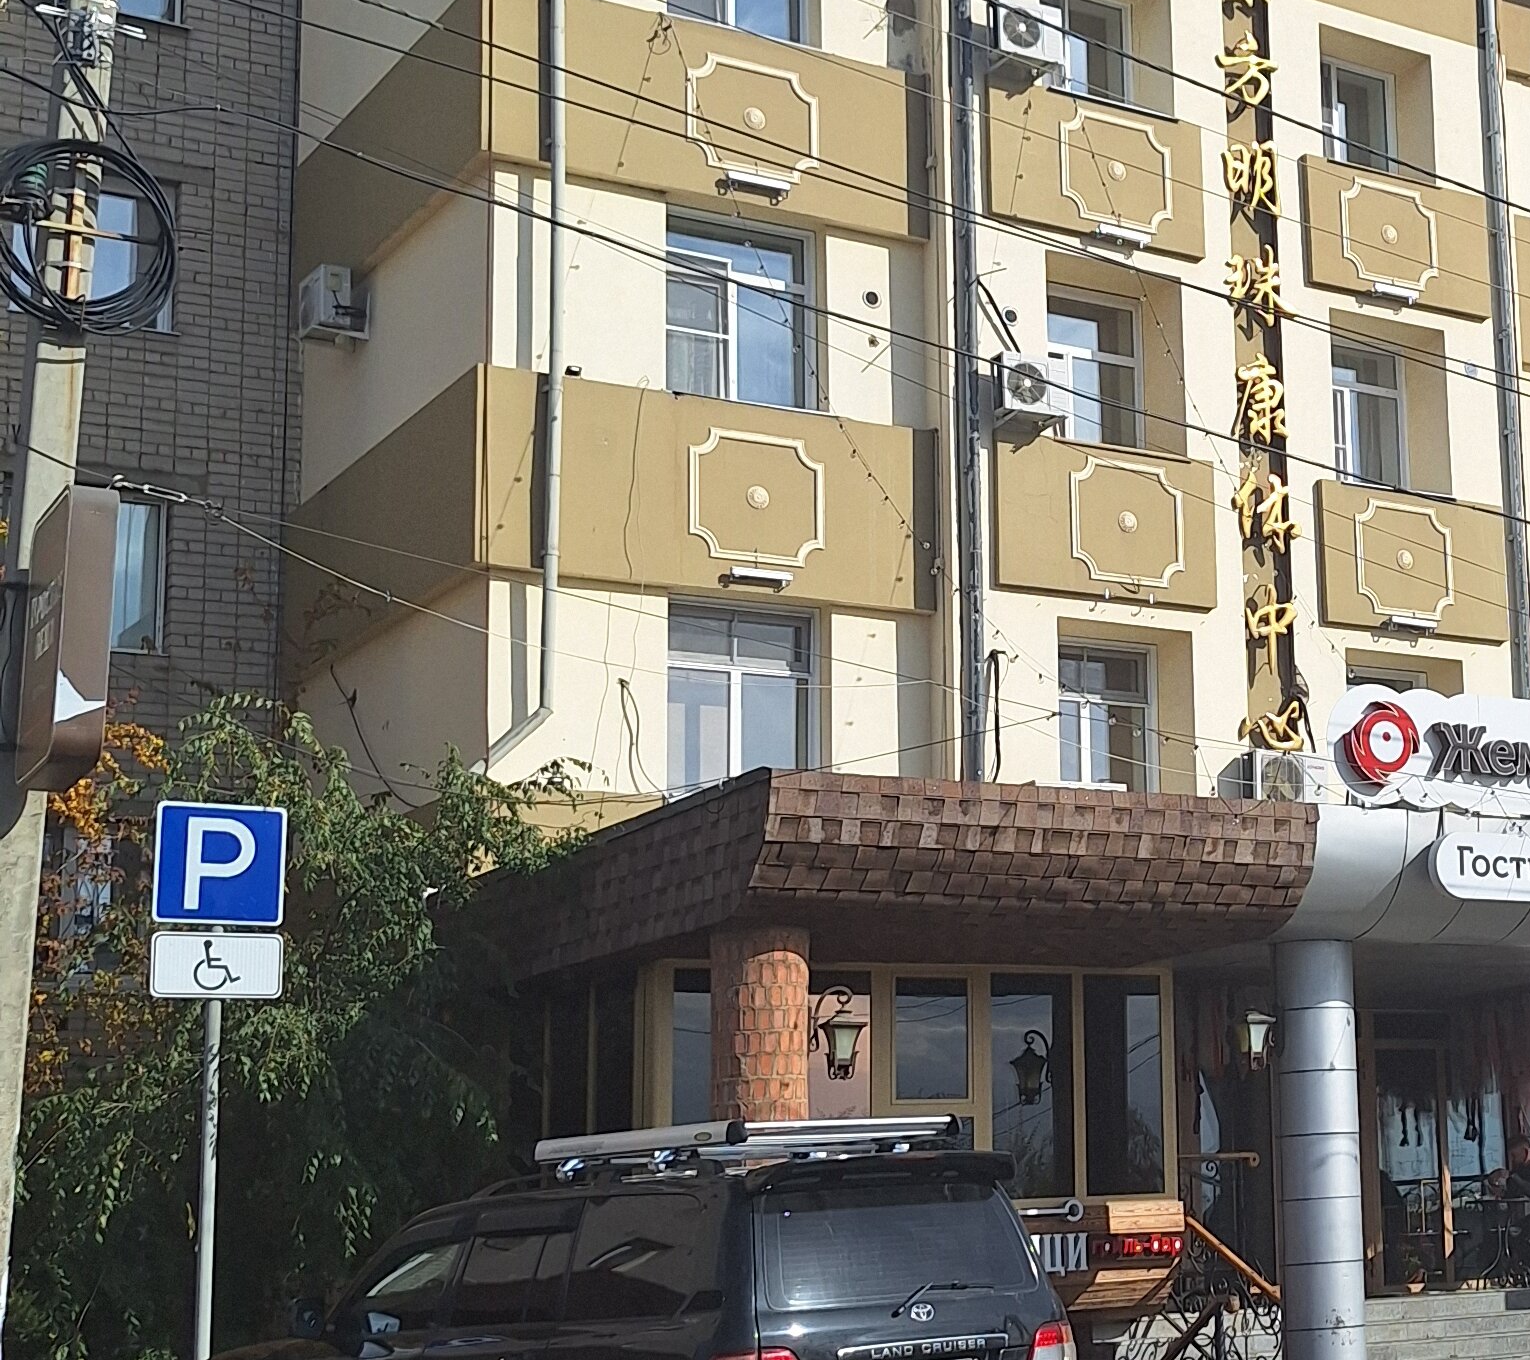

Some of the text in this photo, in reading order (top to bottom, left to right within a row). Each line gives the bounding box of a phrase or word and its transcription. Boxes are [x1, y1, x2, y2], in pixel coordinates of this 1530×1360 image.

[182, 815, 257, 910] P
[871, 1338, 987, 1360] LAND CRUISER
